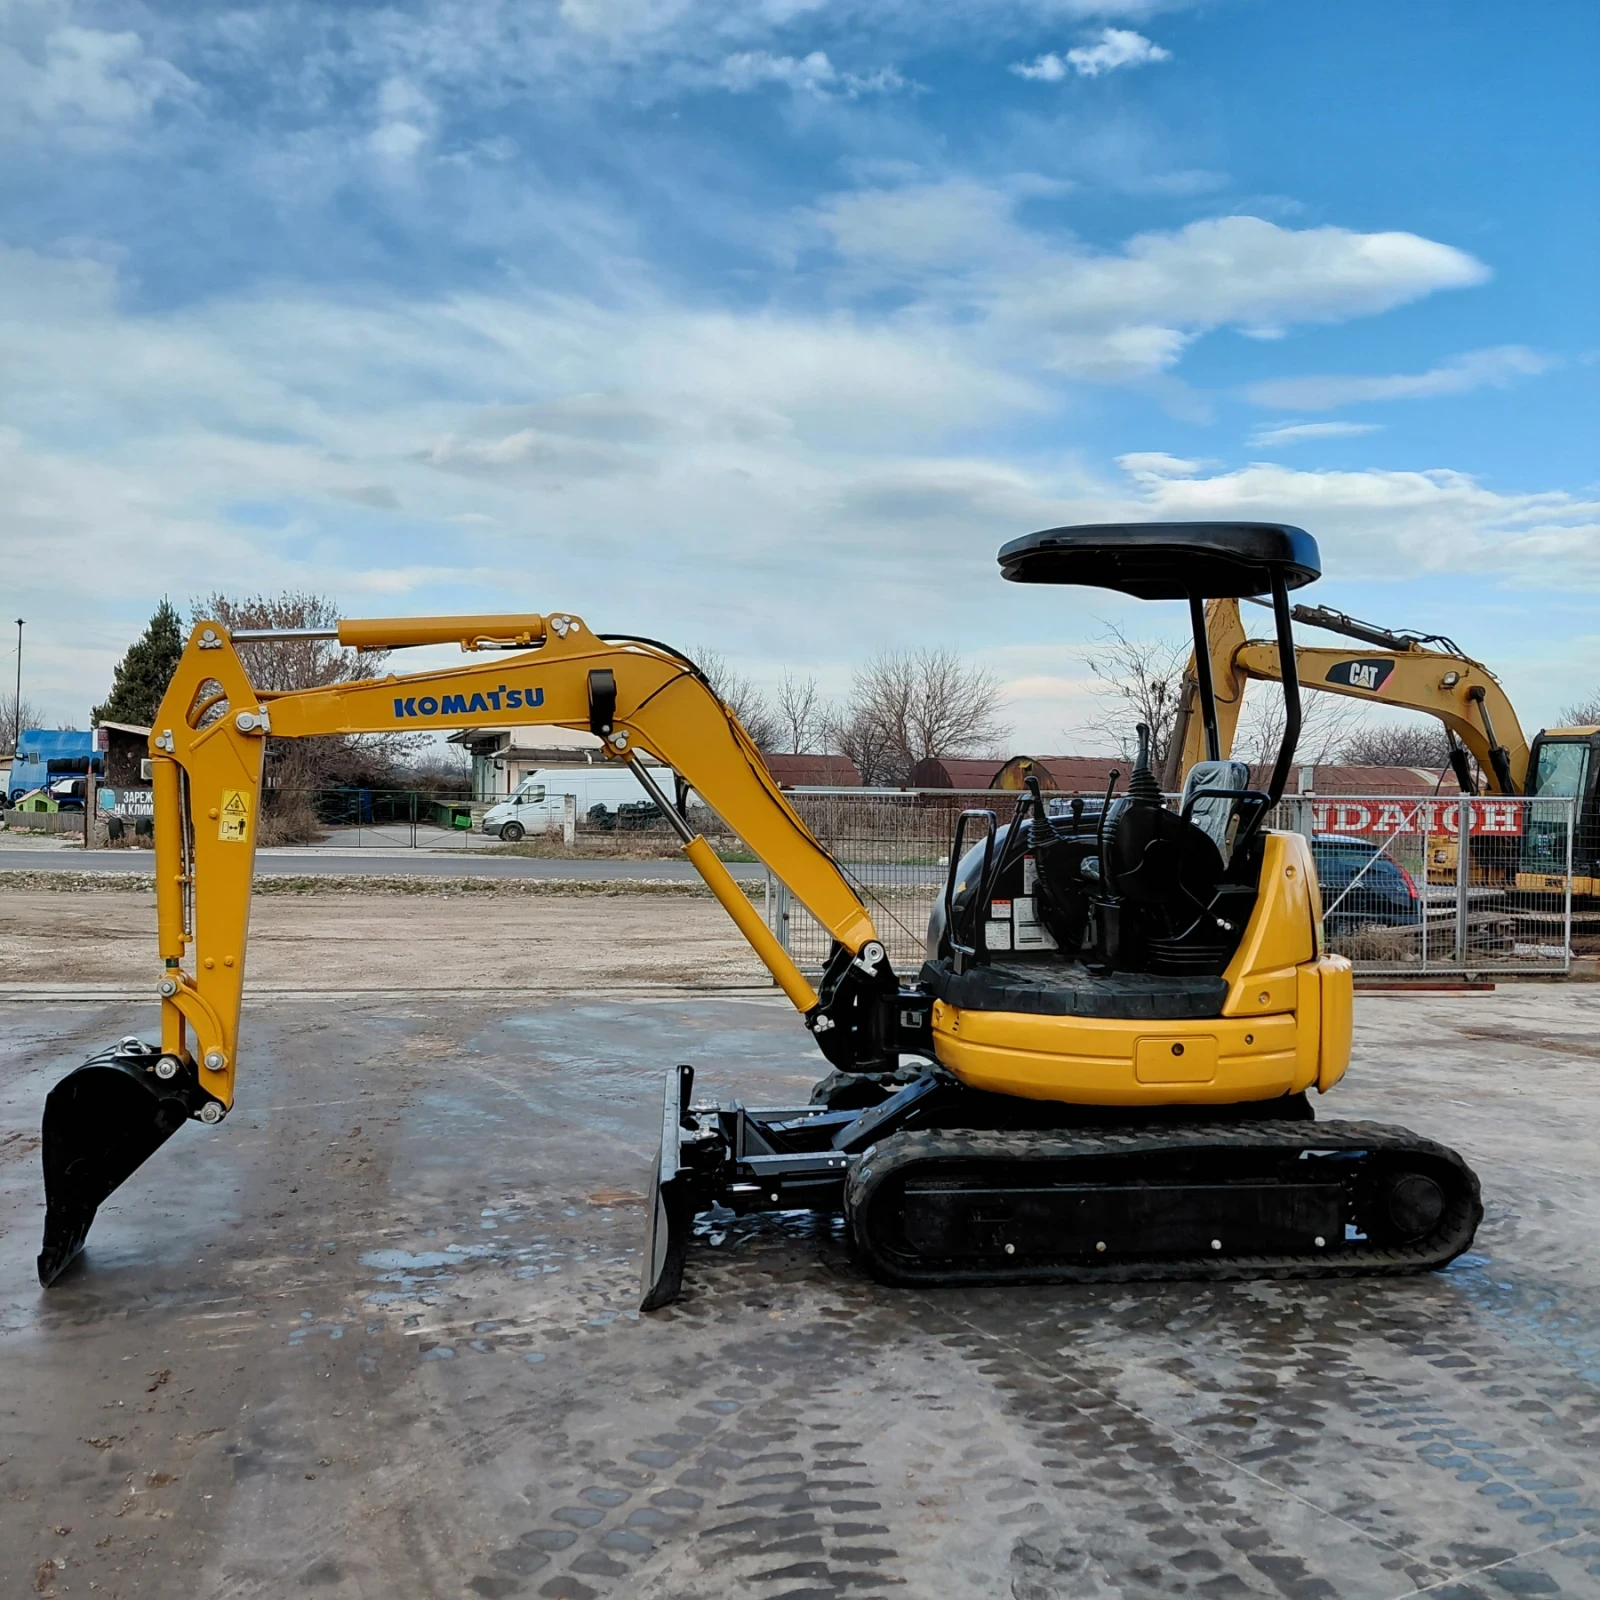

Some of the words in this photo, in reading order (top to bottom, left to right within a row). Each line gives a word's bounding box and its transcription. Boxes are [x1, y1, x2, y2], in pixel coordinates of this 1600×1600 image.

[1349, 662, 1379, 689] CAT
[394, 685, 545, 718] KOMATSU
[115, 803, 126, 815] НА
